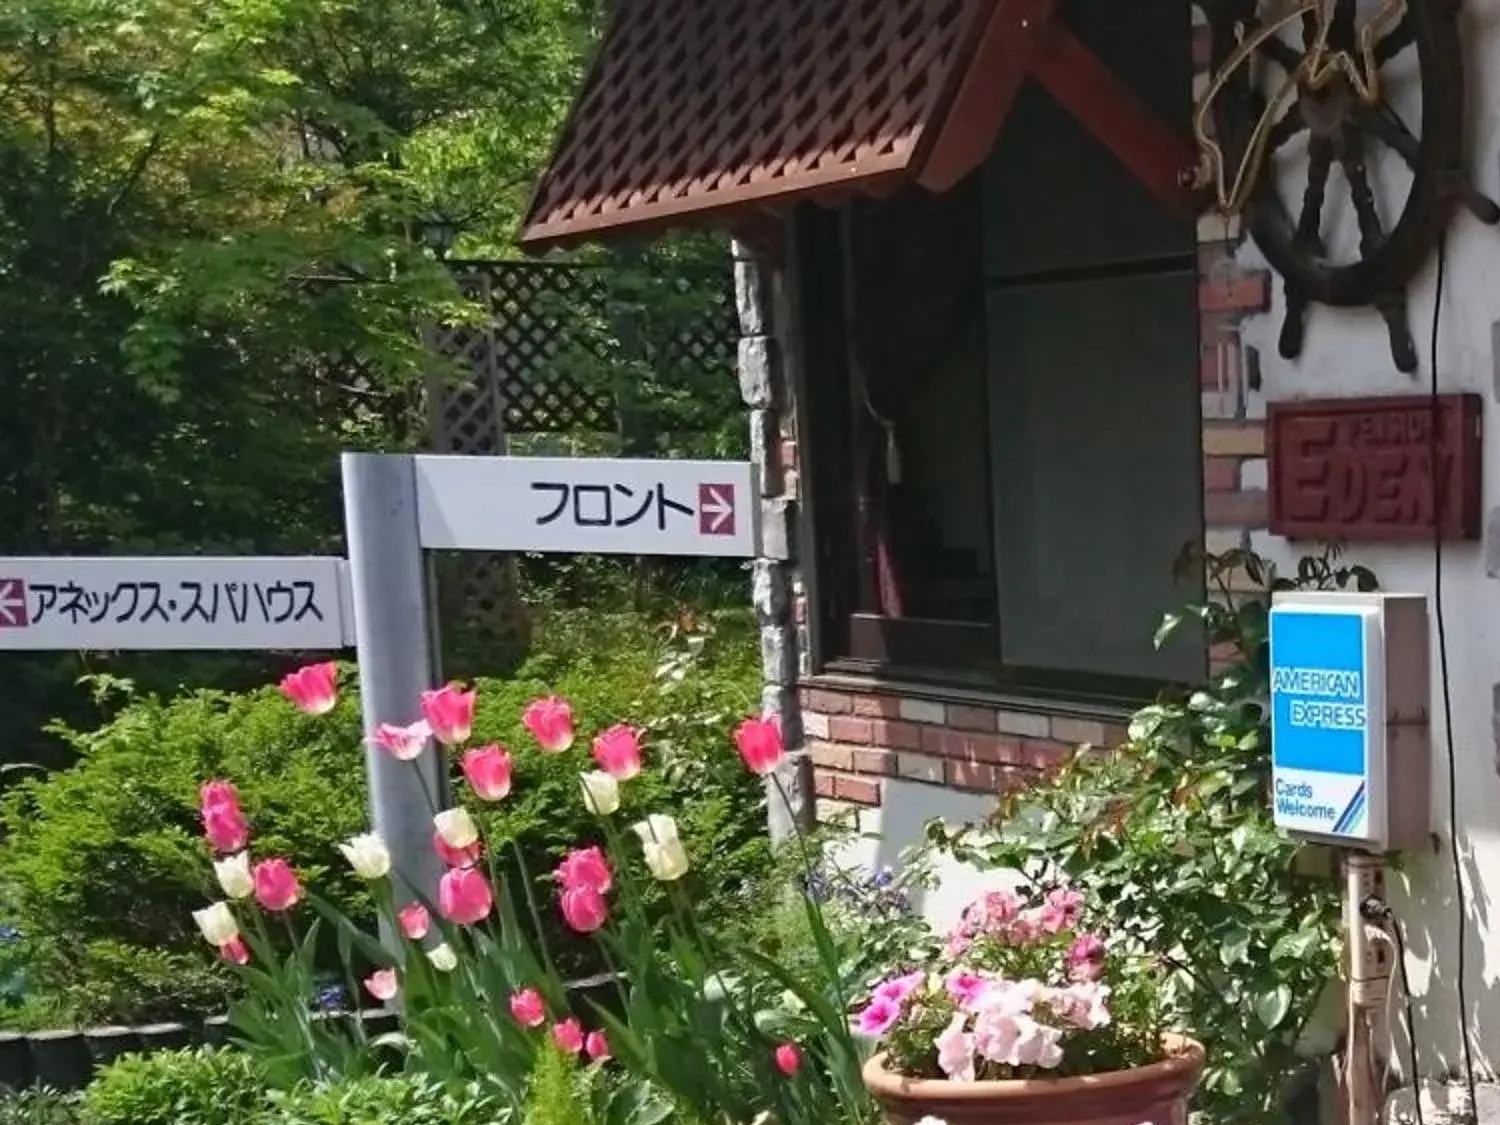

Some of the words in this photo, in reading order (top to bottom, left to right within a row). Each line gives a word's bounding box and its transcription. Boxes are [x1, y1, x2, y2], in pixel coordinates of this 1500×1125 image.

[1283, 416, 1455, 524] EDEN
[531, 482, 694, 530] フロント
[28, 580, 323, 624] アネックス・スパハウス
[1273, 668, 1360, 696] AMERICAN
[1291, 701, 1366, 729] EXPRESS
[1275, 778, 1313, 799] Cards
[1276, 800, 1336, 820] Welcome
